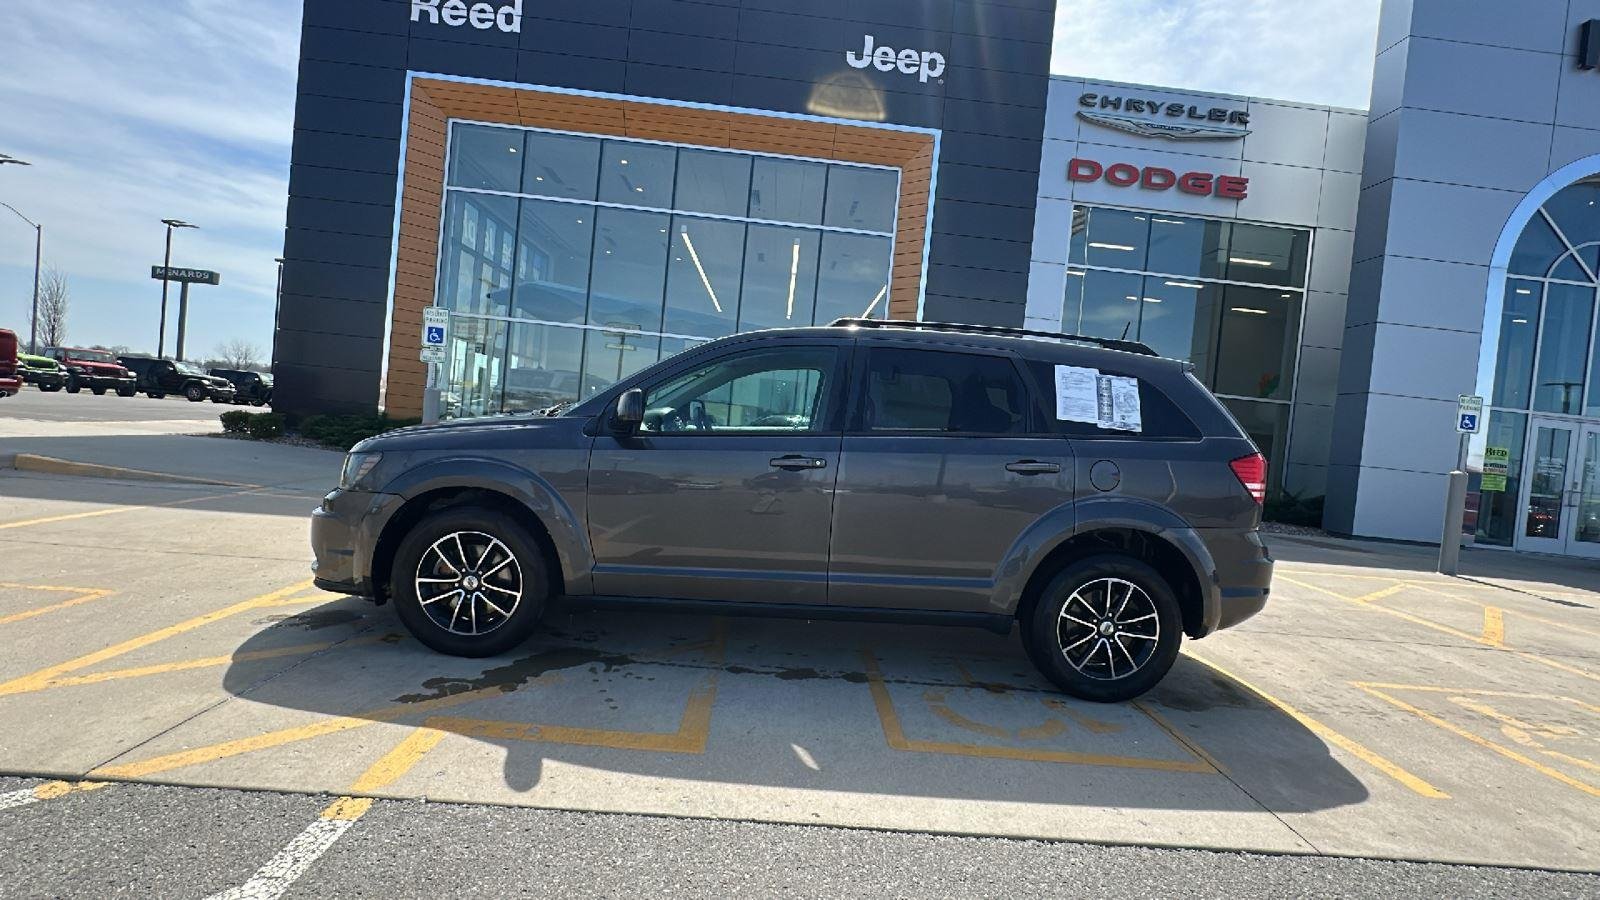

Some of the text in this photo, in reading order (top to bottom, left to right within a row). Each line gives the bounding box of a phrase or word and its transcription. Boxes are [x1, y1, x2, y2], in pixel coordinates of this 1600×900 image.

[410, 0, 524, 34] Reed
[846, 34, 946, 83] Jeep
[1078, 93, 1250, 124] CHRYSLER
[1068, 157, 1250, 200] DODGE
